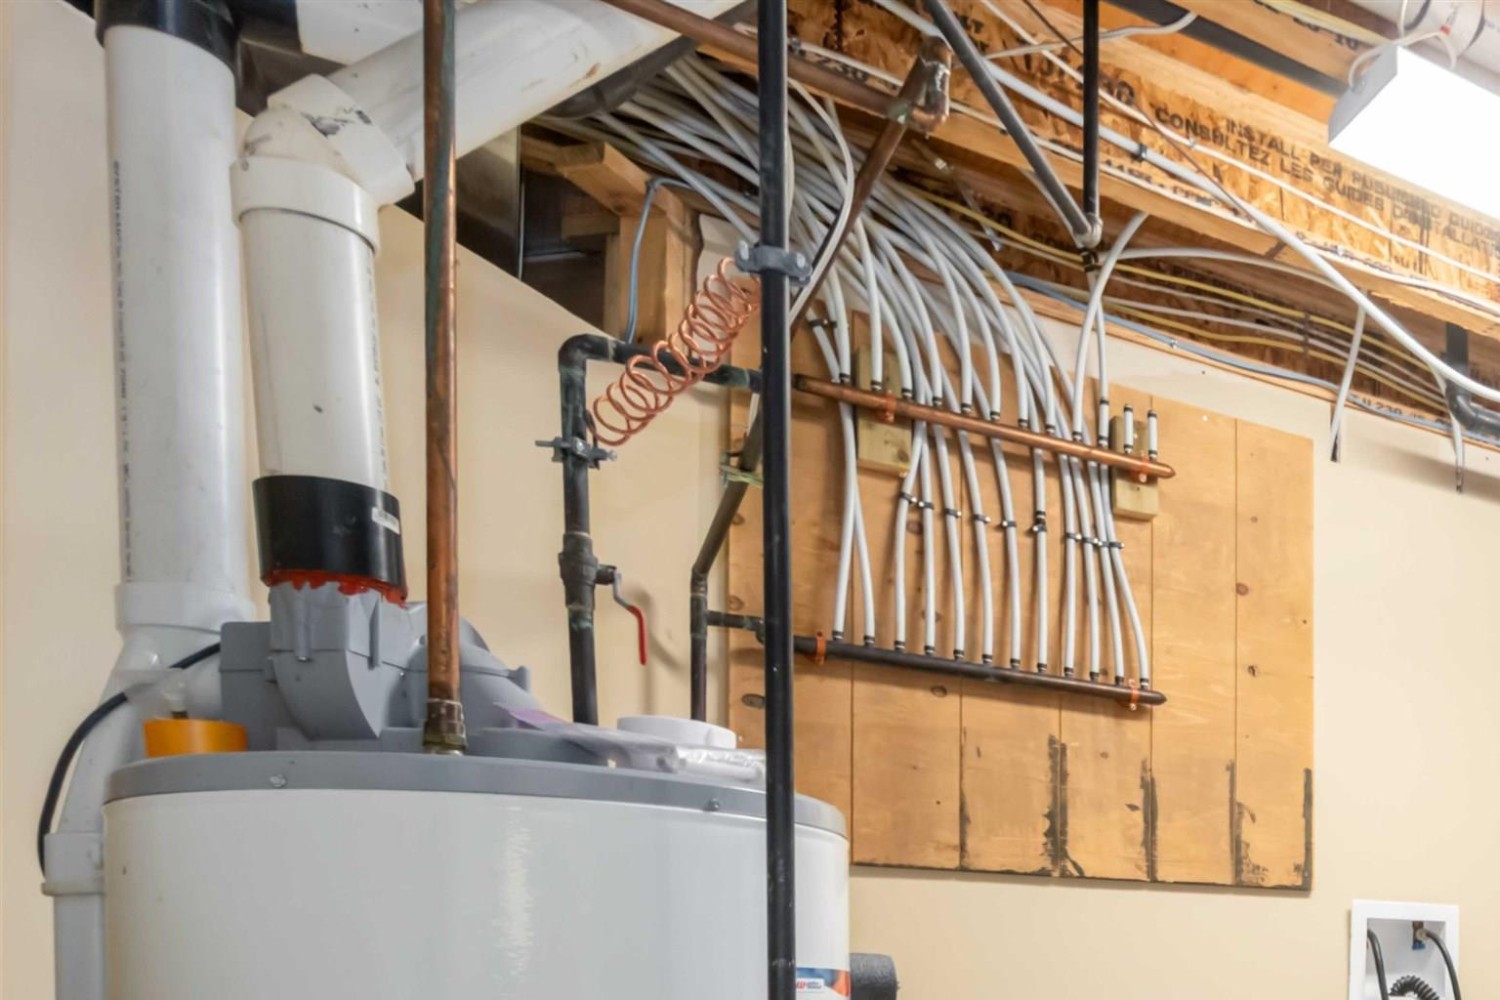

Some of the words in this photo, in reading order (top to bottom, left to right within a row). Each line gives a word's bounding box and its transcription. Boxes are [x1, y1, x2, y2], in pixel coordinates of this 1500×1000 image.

[1225, 117, 1301, 160] INSTALL
[1309, 151, 1343, 176] PER
[1278, 155, 1314, 184] LES
[1322, 175, 1385, 212] GUIDES
